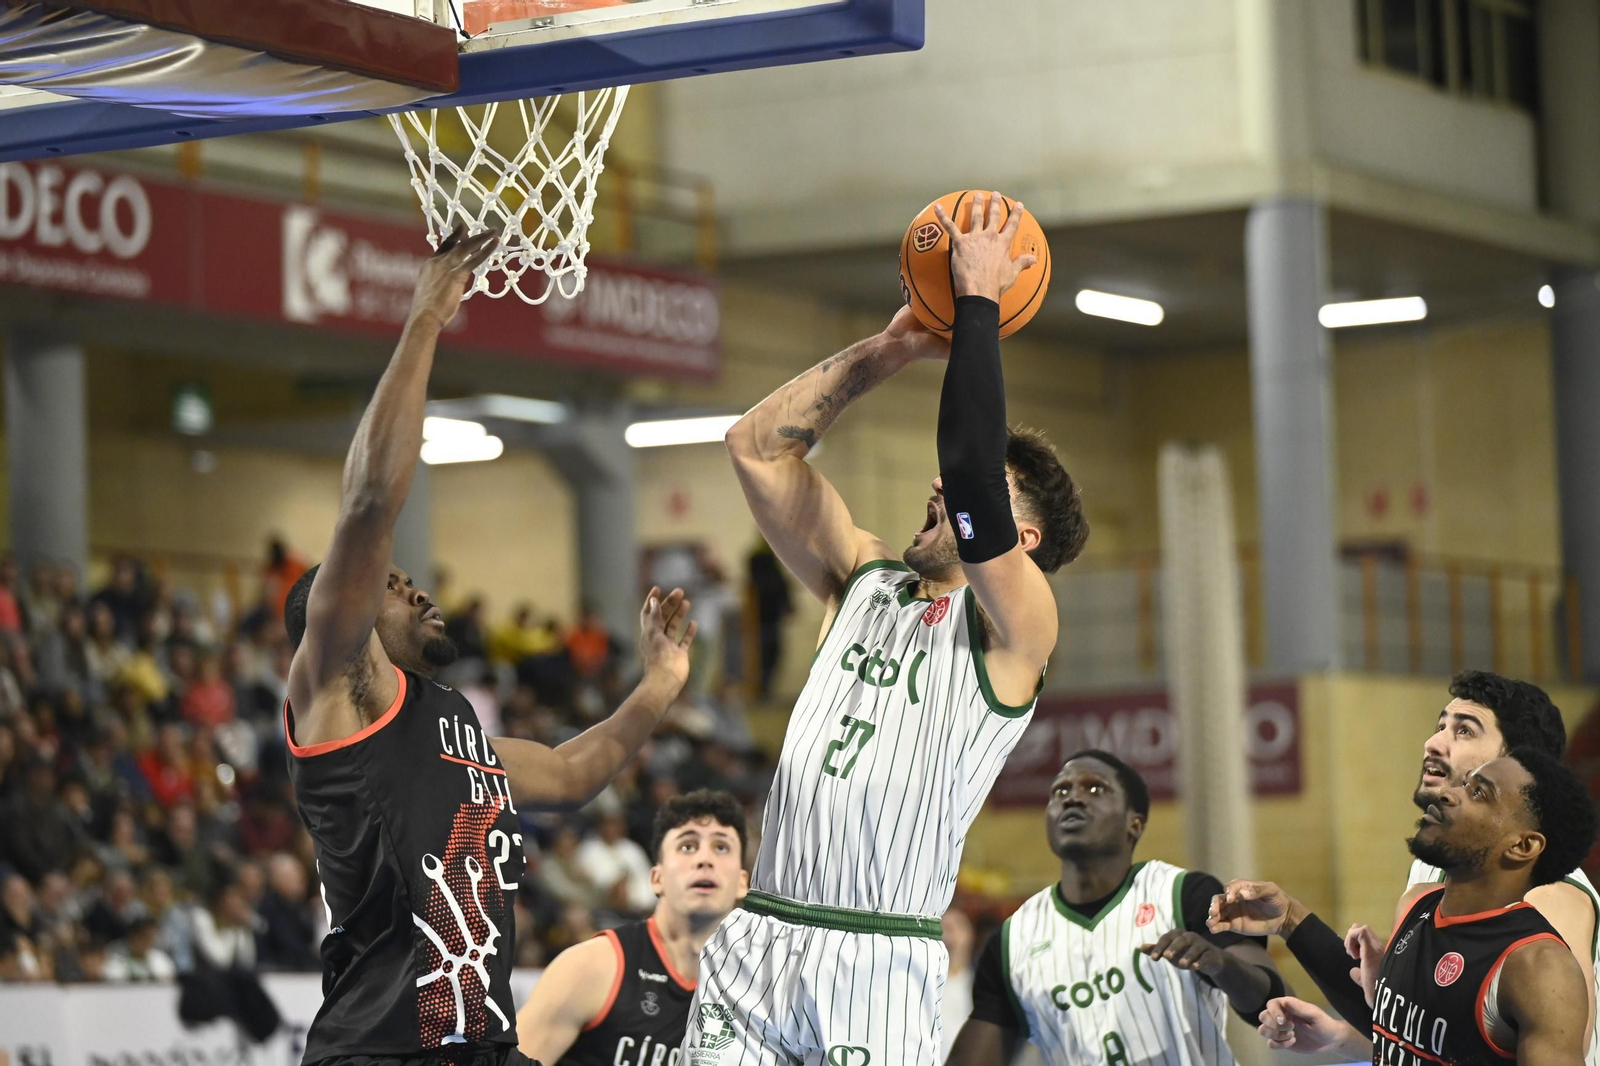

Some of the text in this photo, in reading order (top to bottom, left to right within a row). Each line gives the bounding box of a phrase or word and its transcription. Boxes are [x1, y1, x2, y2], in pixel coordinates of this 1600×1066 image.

[0, 161, 152, 259] DECO
[824, 714, 876, 780] 27
[1051, 966, 1125, 1011] coto
[1372, 976, 1448, 1056] ÍRCULO
